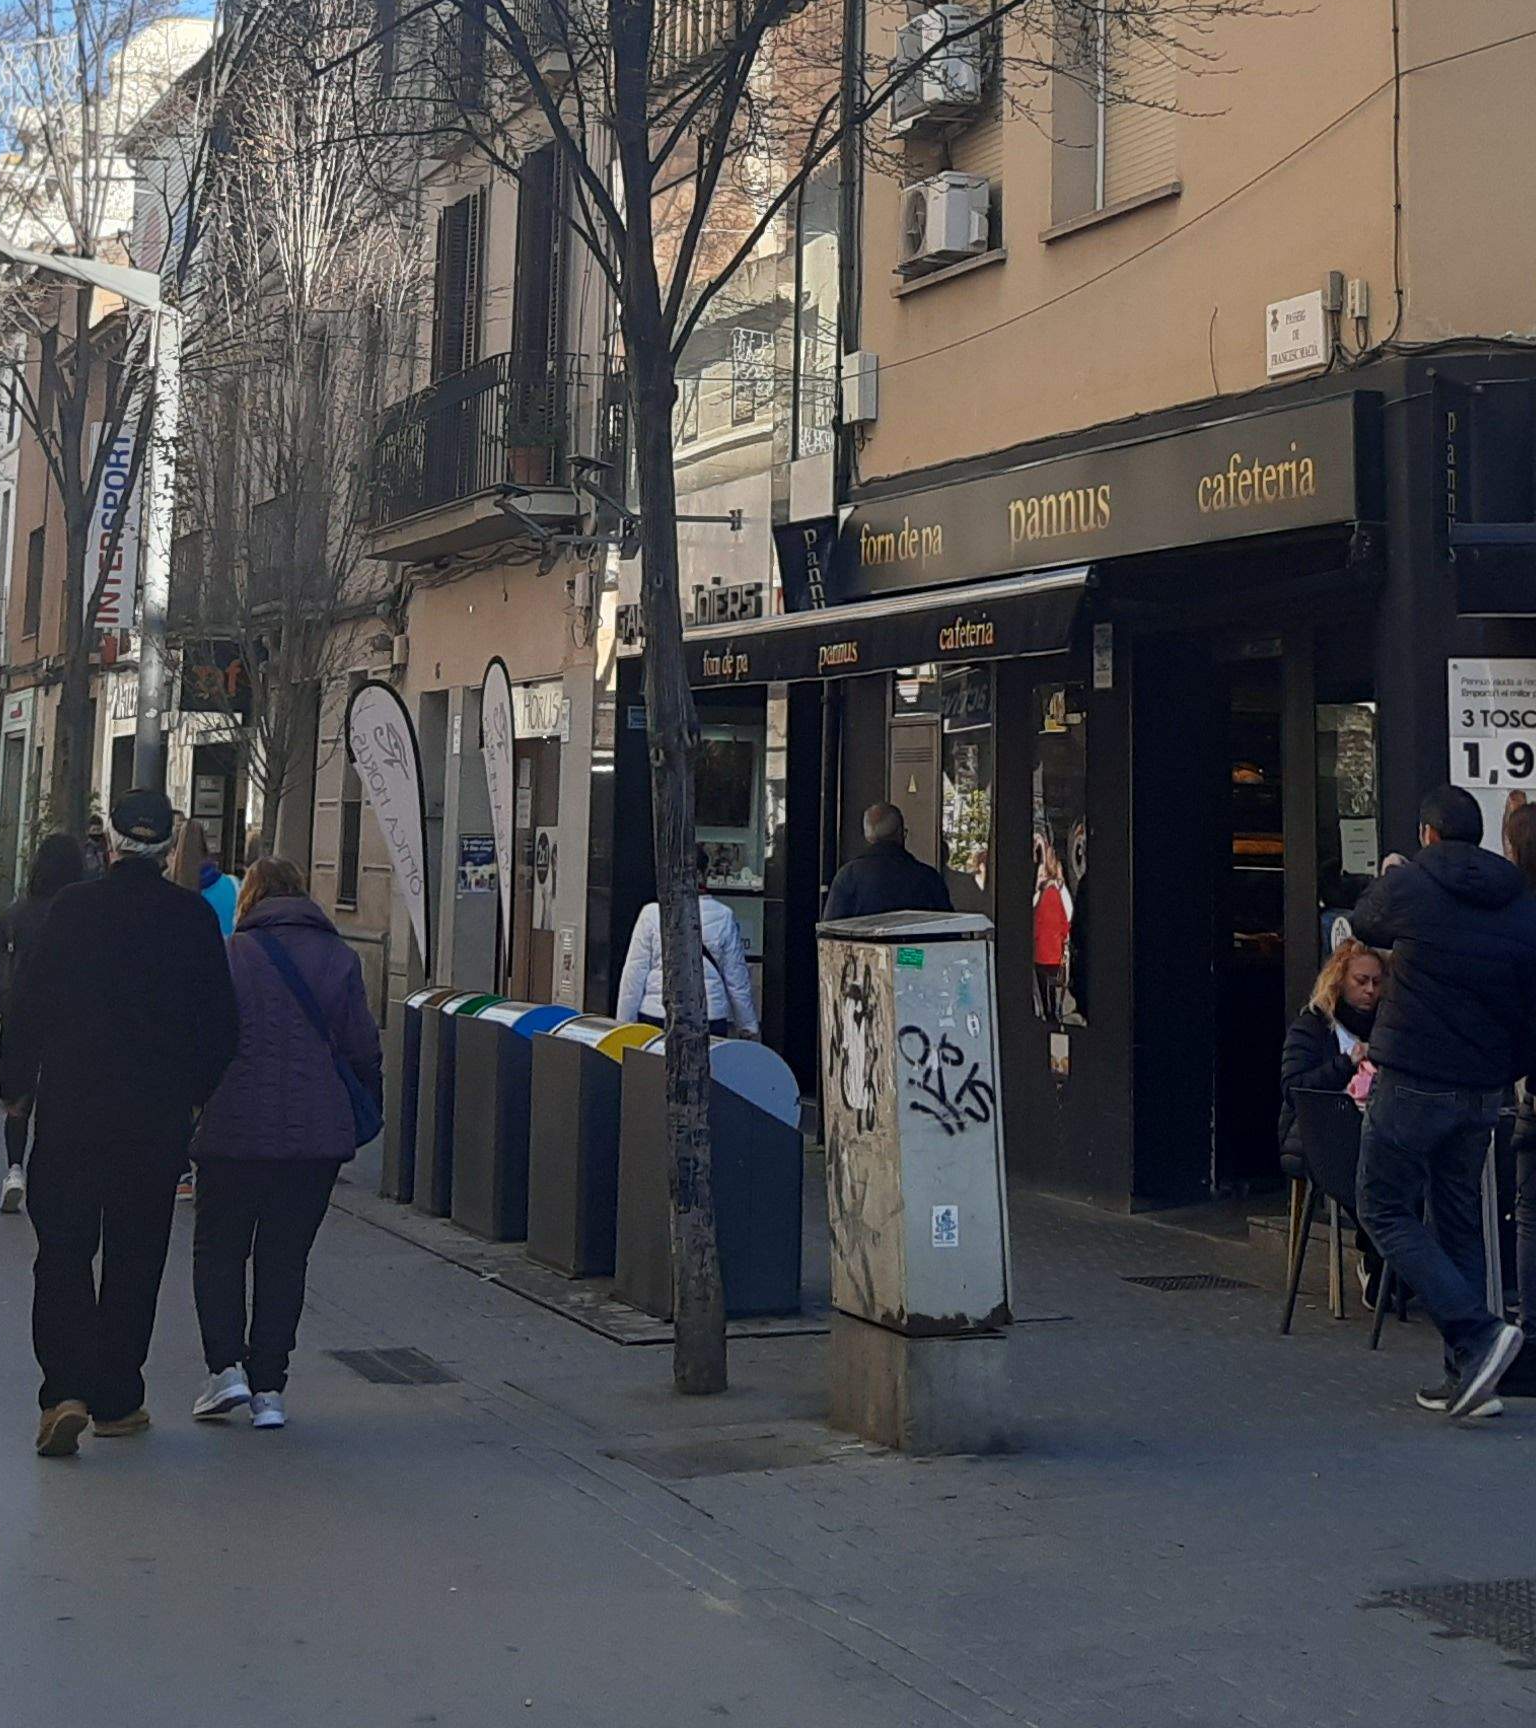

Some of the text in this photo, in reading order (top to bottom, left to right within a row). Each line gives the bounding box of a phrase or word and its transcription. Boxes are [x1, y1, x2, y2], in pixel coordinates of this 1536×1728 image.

[1197, 441, 1317, 514] cafeteria
[1007, 482, 1112, 558] pannus
[859, 516, 944, 570] forn de pa
[939, 613, 994, 652] cafeteria
[818, 642, 859, 674] pannus
[522, 691, 560, 730] HORUS
[1461, 709, 1475, 728] 3
